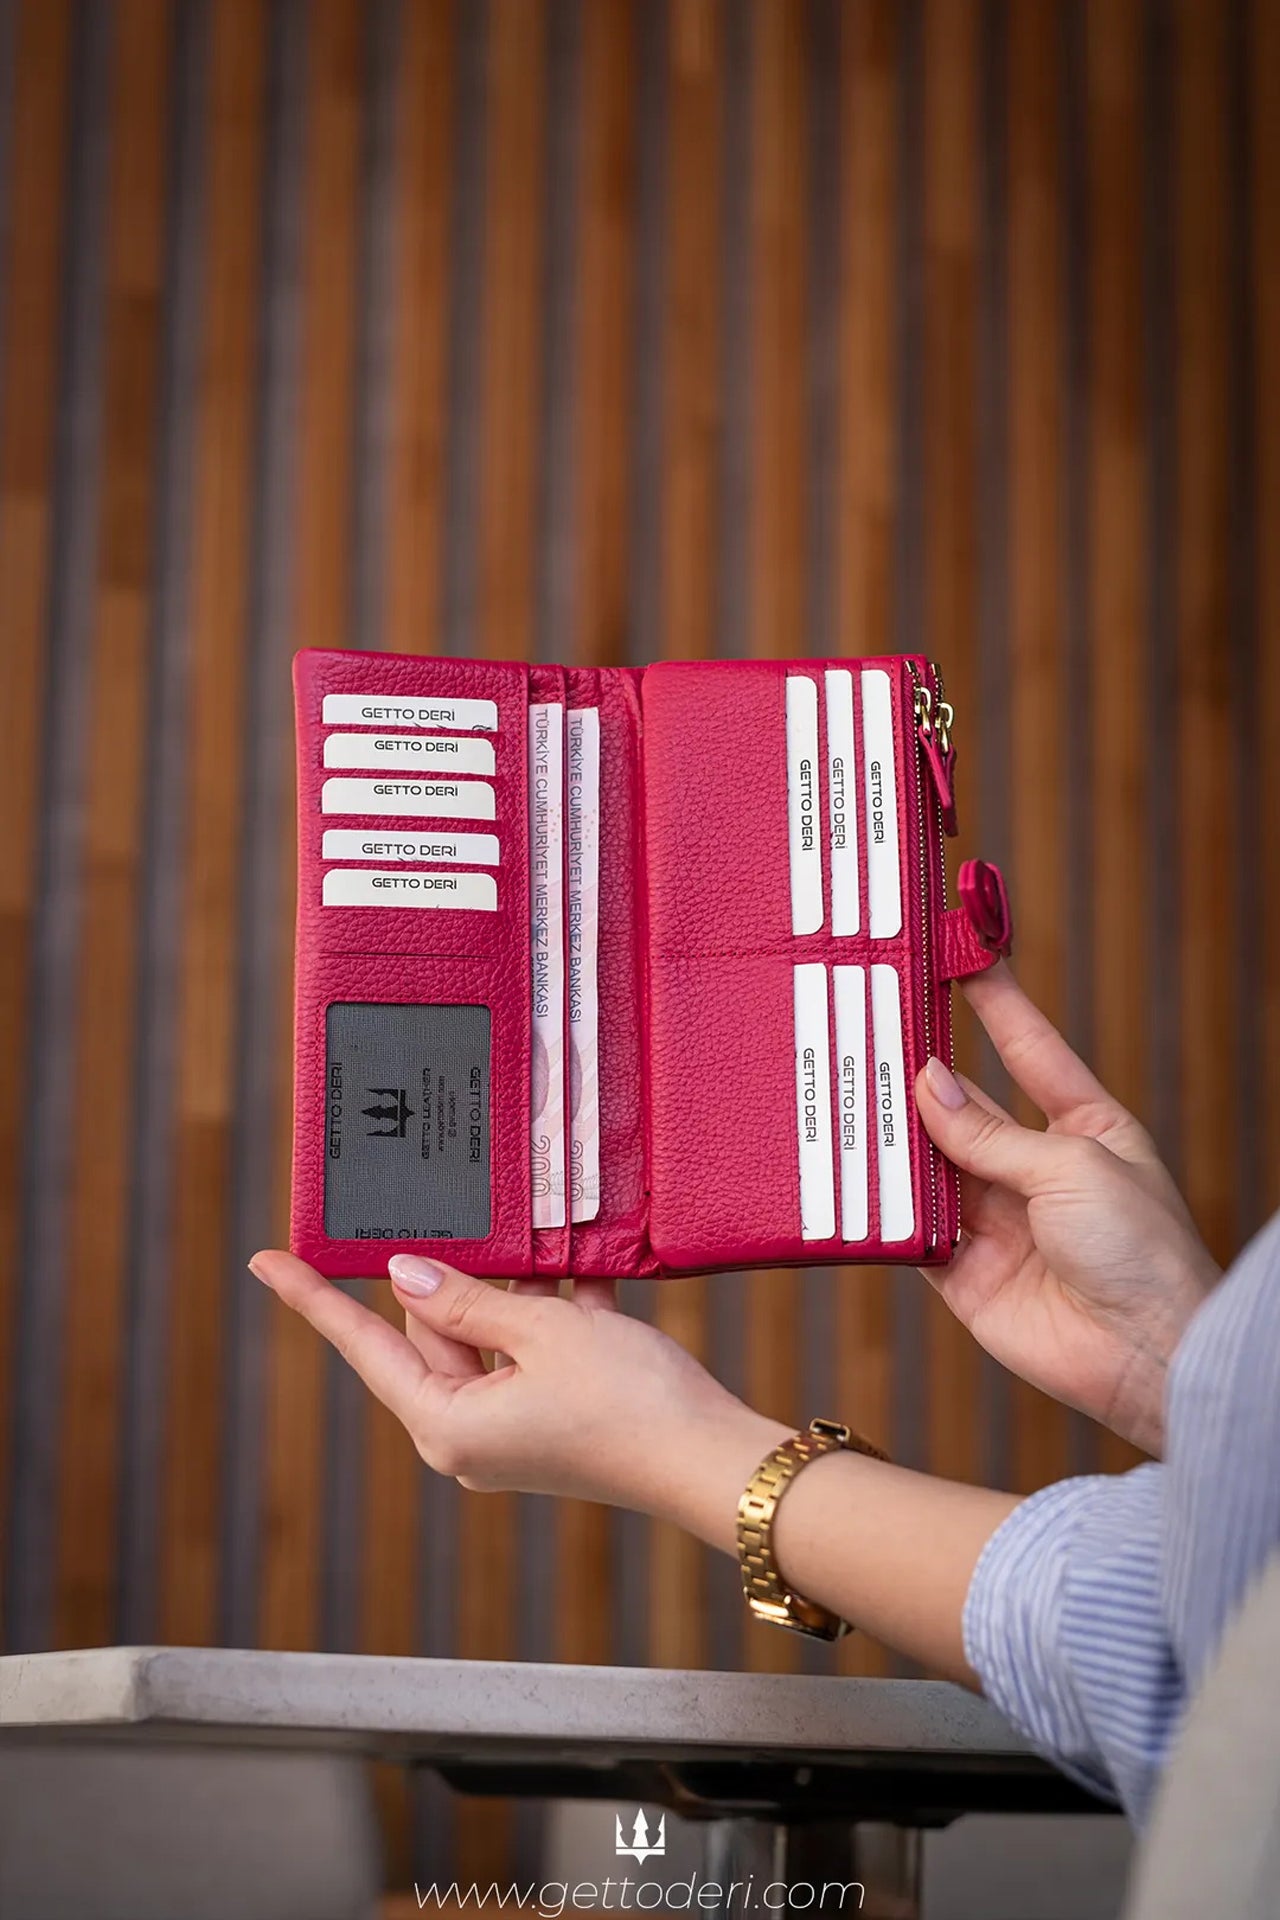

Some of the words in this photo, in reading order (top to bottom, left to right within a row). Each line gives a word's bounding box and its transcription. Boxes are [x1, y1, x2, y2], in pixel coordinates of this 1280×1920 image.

[361, 707, 415, 720] GETTO
[418, 708, 455, 721] DERİ
[374, 740, 422, 752] GETTO
[425, 741, 459, 753] DERİ
[536, 709, 550, 774] TÜRKİYE
[570, 718, 584, 782] TÜRKİYE
[373, 785, 422, 796] GETTO
[425, 785, 459, 797] DERİ
[800, 759, 813, 811] GETTO
[832, 757, 845, 809] GETTO
[870, 761, 882, 808] GETTO
[362, 843, 416, 856] GETTO
[419, 843, 457, 857] DERİ
[536, 778, 549, 879] CUMHURİYET
[570, 786, 584, 884] CUMHURİYET
[801, 815, 815, 851] DERİ
[834, 813, 848, 849] DERİ
[873, 811, 887, 844] DERİ
[371, 877, 420, 889] GETTO
[423, 878, 457, 890] DERİ
[536, 884, 548, 947] MERKEZ
[570, 890, 582, 953] MERKEZ
[536, 951, 549, 1018] BANKASI
[570, 958, 582, 1023] BANKASI
[470, 1067, 481, 1121] GETTO
[803, 1048, 816, 1101] GETTO
[842, 1055, 855, 1109] GETTO
[879, 1062, 892, 1110] GETTO
[330, 1104, 342, 1160] GETTO
[421, 1122, 431, 1160] GETTO
[805, 1105, 818, 1143] DERİ
[844, 1113, 858, 1150] DERİ
[881, 1113, 896, 1147] DERİ
